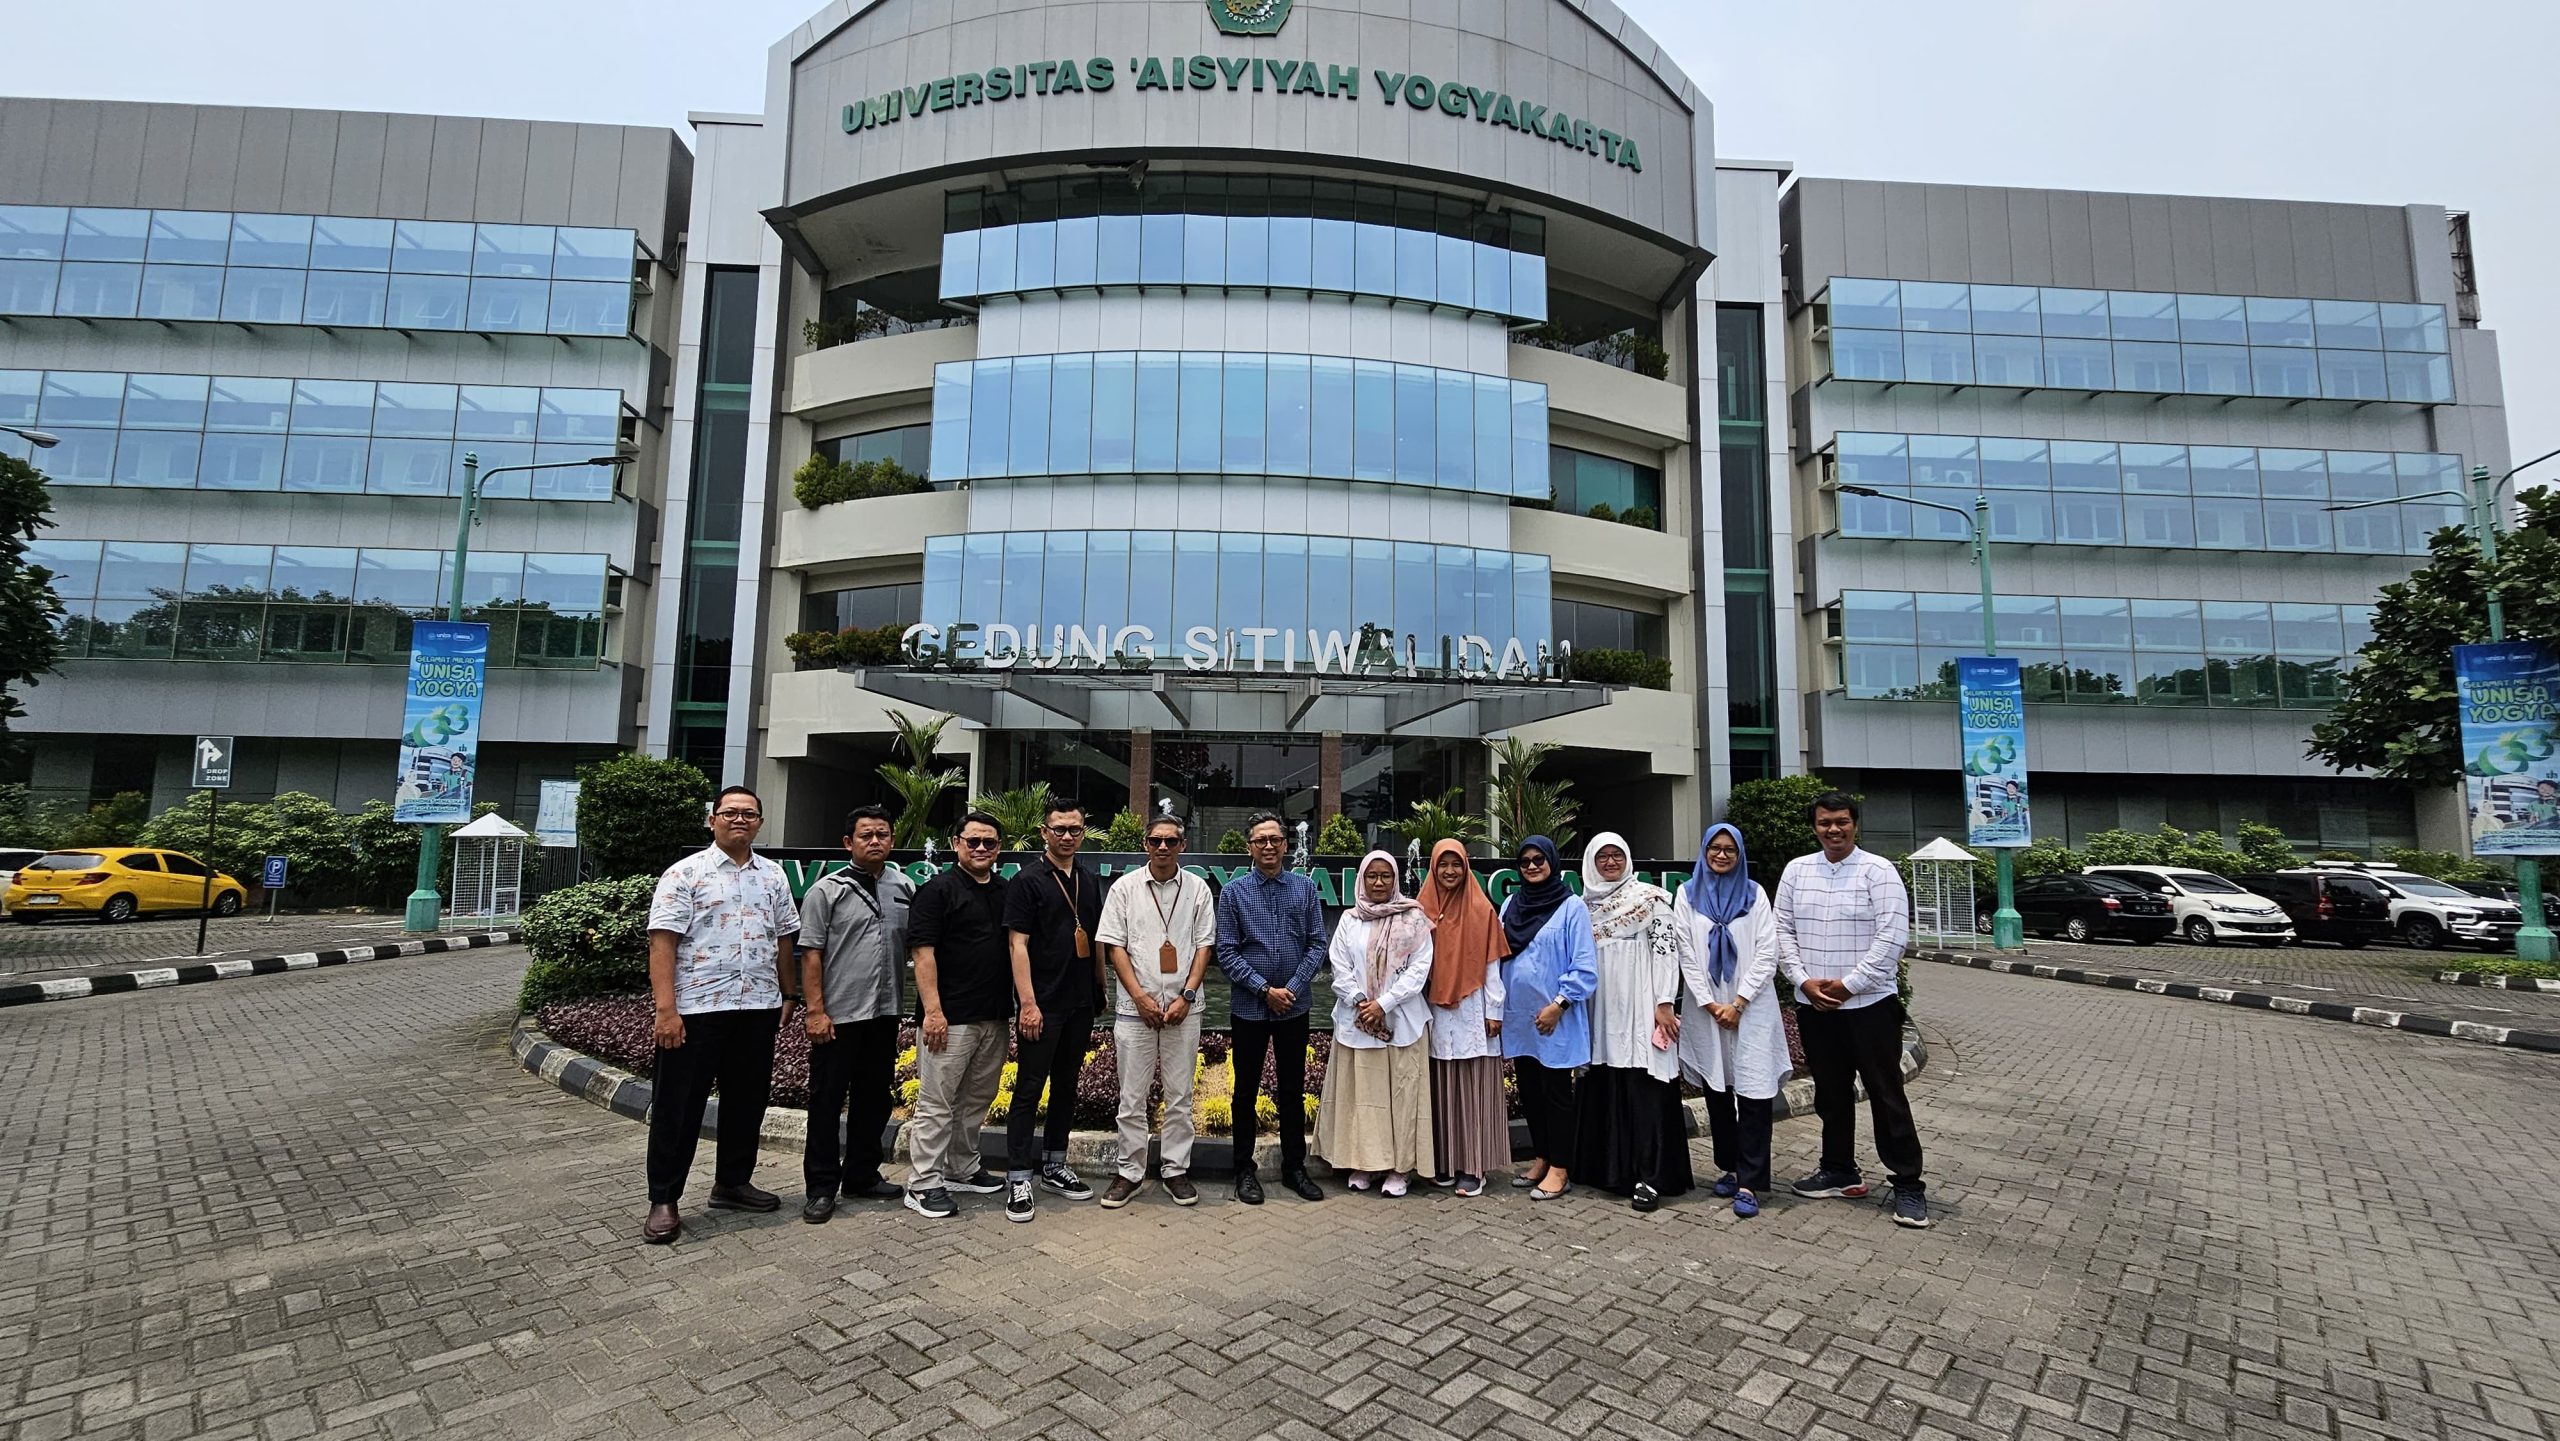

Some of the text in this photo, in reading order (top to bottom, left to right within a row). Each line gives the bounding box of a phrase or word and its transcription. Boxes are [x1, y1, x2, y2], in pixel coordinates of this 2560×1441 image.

[841, 55, 1642, 173] UNIVERSITAS 'AISYIYAH YOGYAKARTA
[900, 623, 1155, 670] GEDUNG
[420, 663, 476, 680] UNISA
[416, 680, 478, 697] YOGYA
[2471, 685, 2549, 705] UNISA
[1970, 697, 2014, 711] UNISA
[2468, 703, 2557, 723] YOGYA
[1967, 713, 2019, 728] YOGYA
